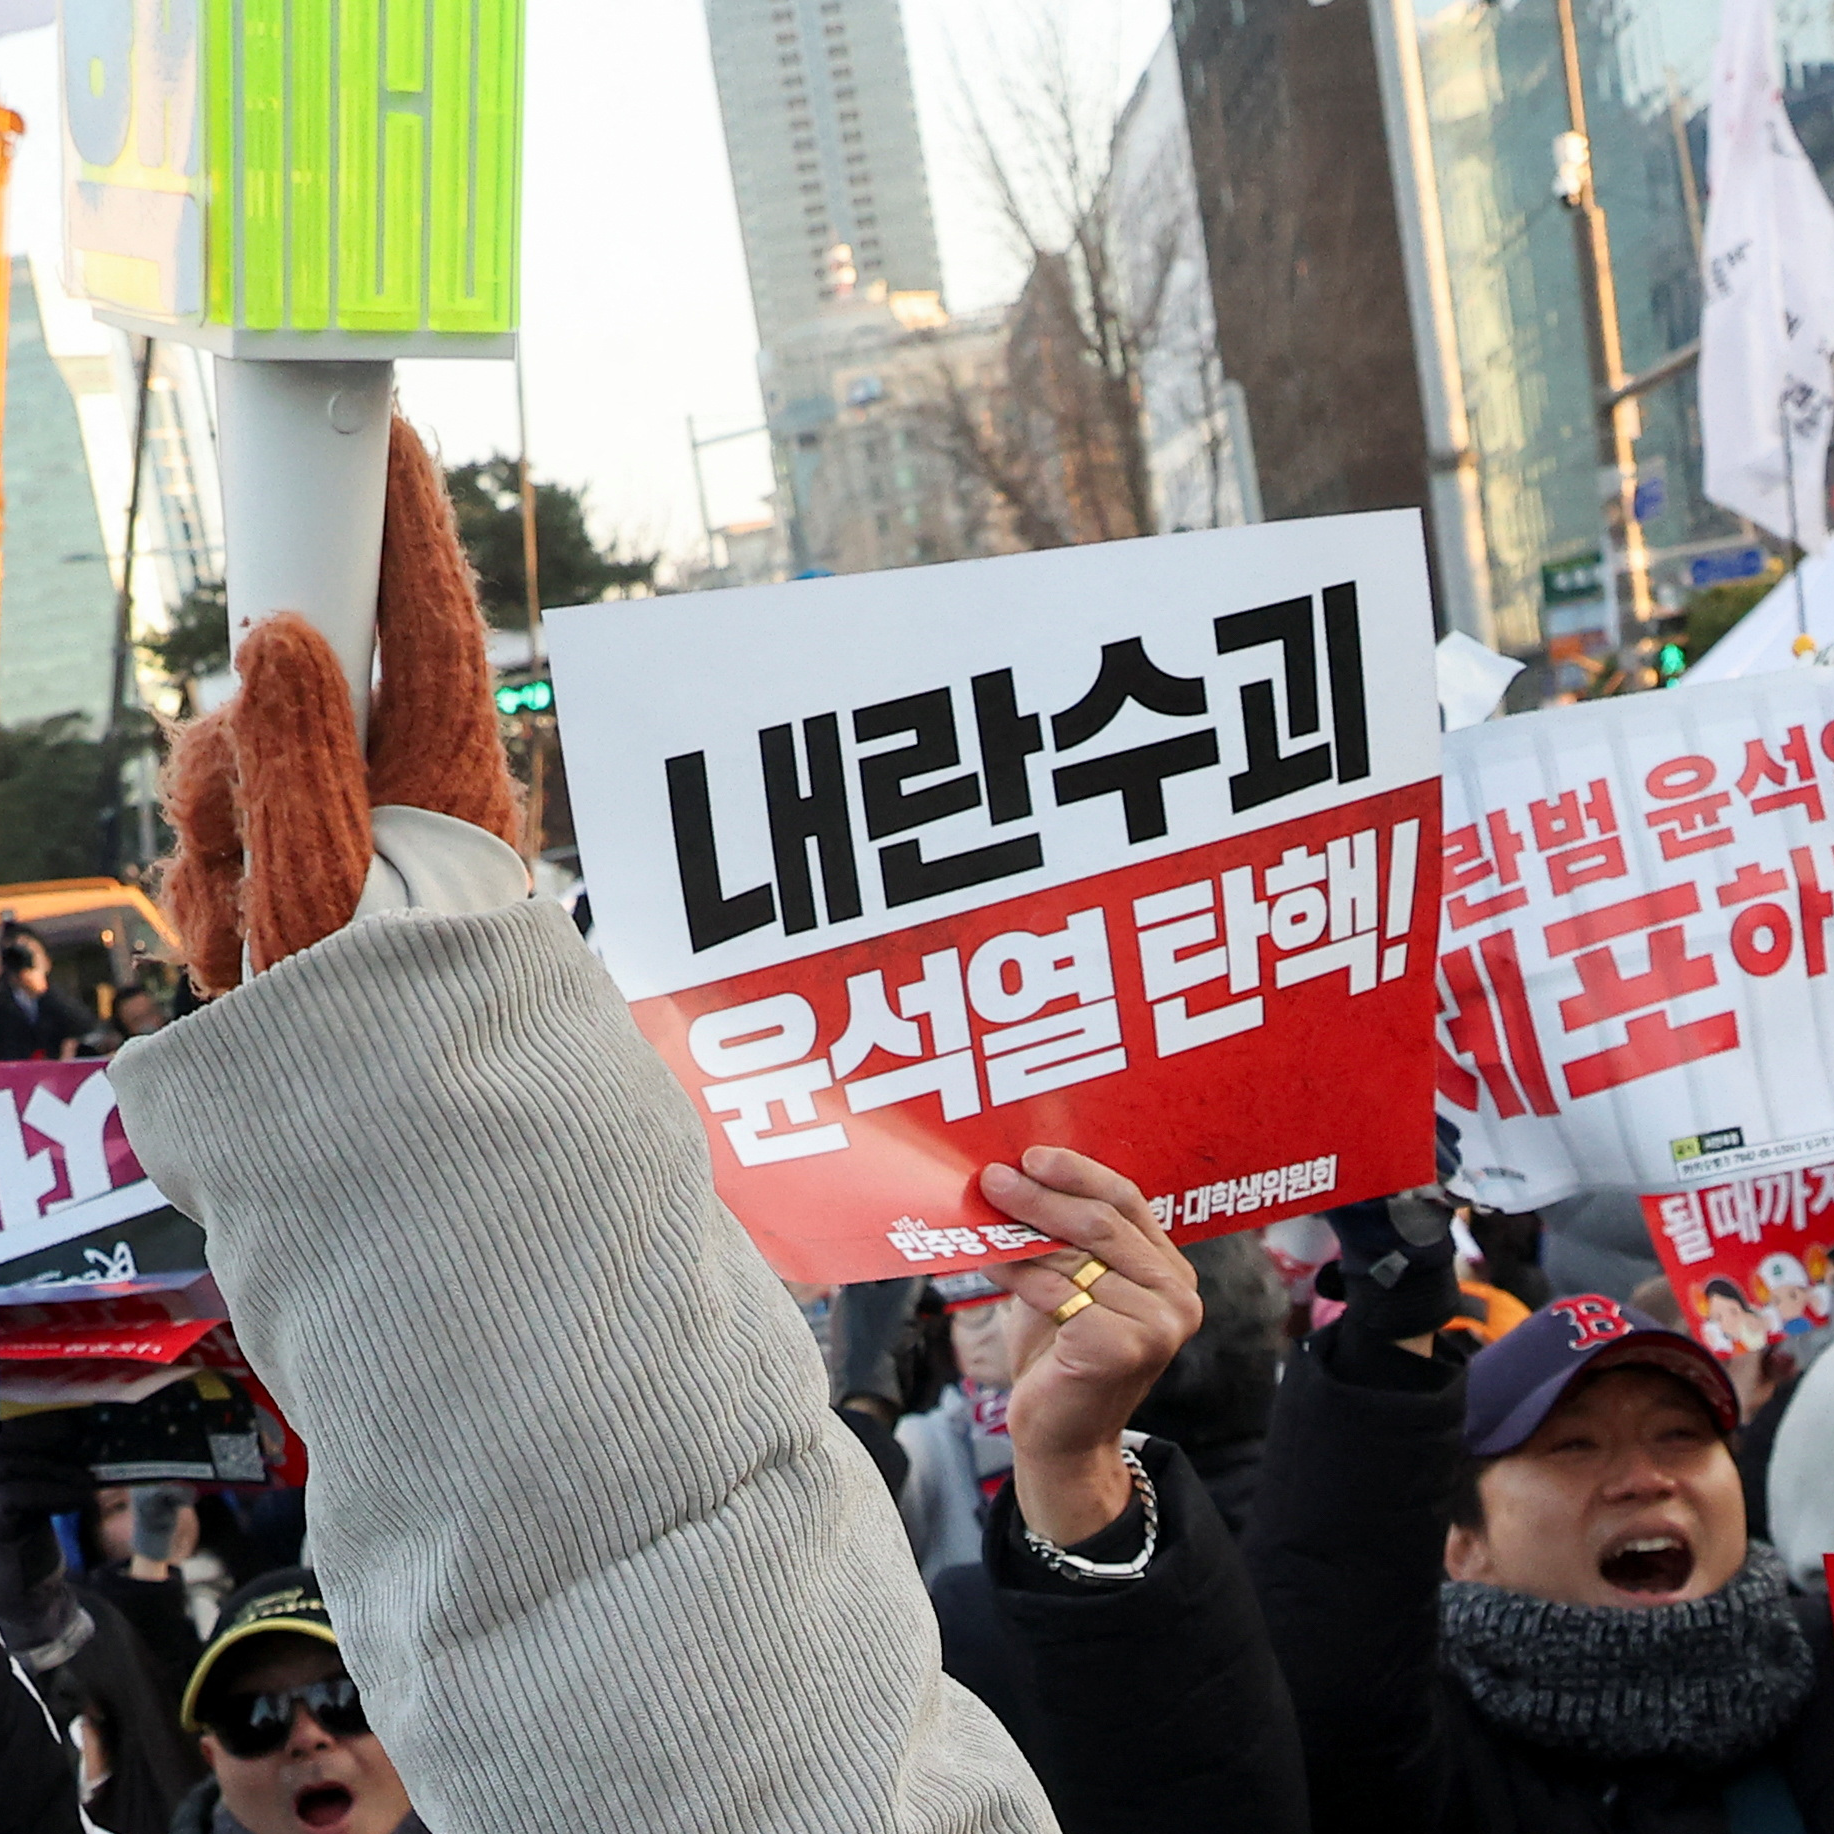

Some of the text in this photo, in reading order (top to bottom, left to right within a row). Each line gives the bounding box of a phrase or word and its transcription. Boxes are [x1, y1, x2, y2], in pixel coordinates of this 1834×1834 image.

[665, 580, 1373, 955] 내란수괴
[688, 817, 1421, 1169] 윤석열 탄핵!
[886, 1224, 988, 1263] 민주당
[981, 1221, 1052, 1252] 전국
[1551, 1292, 1634, 1351] B
